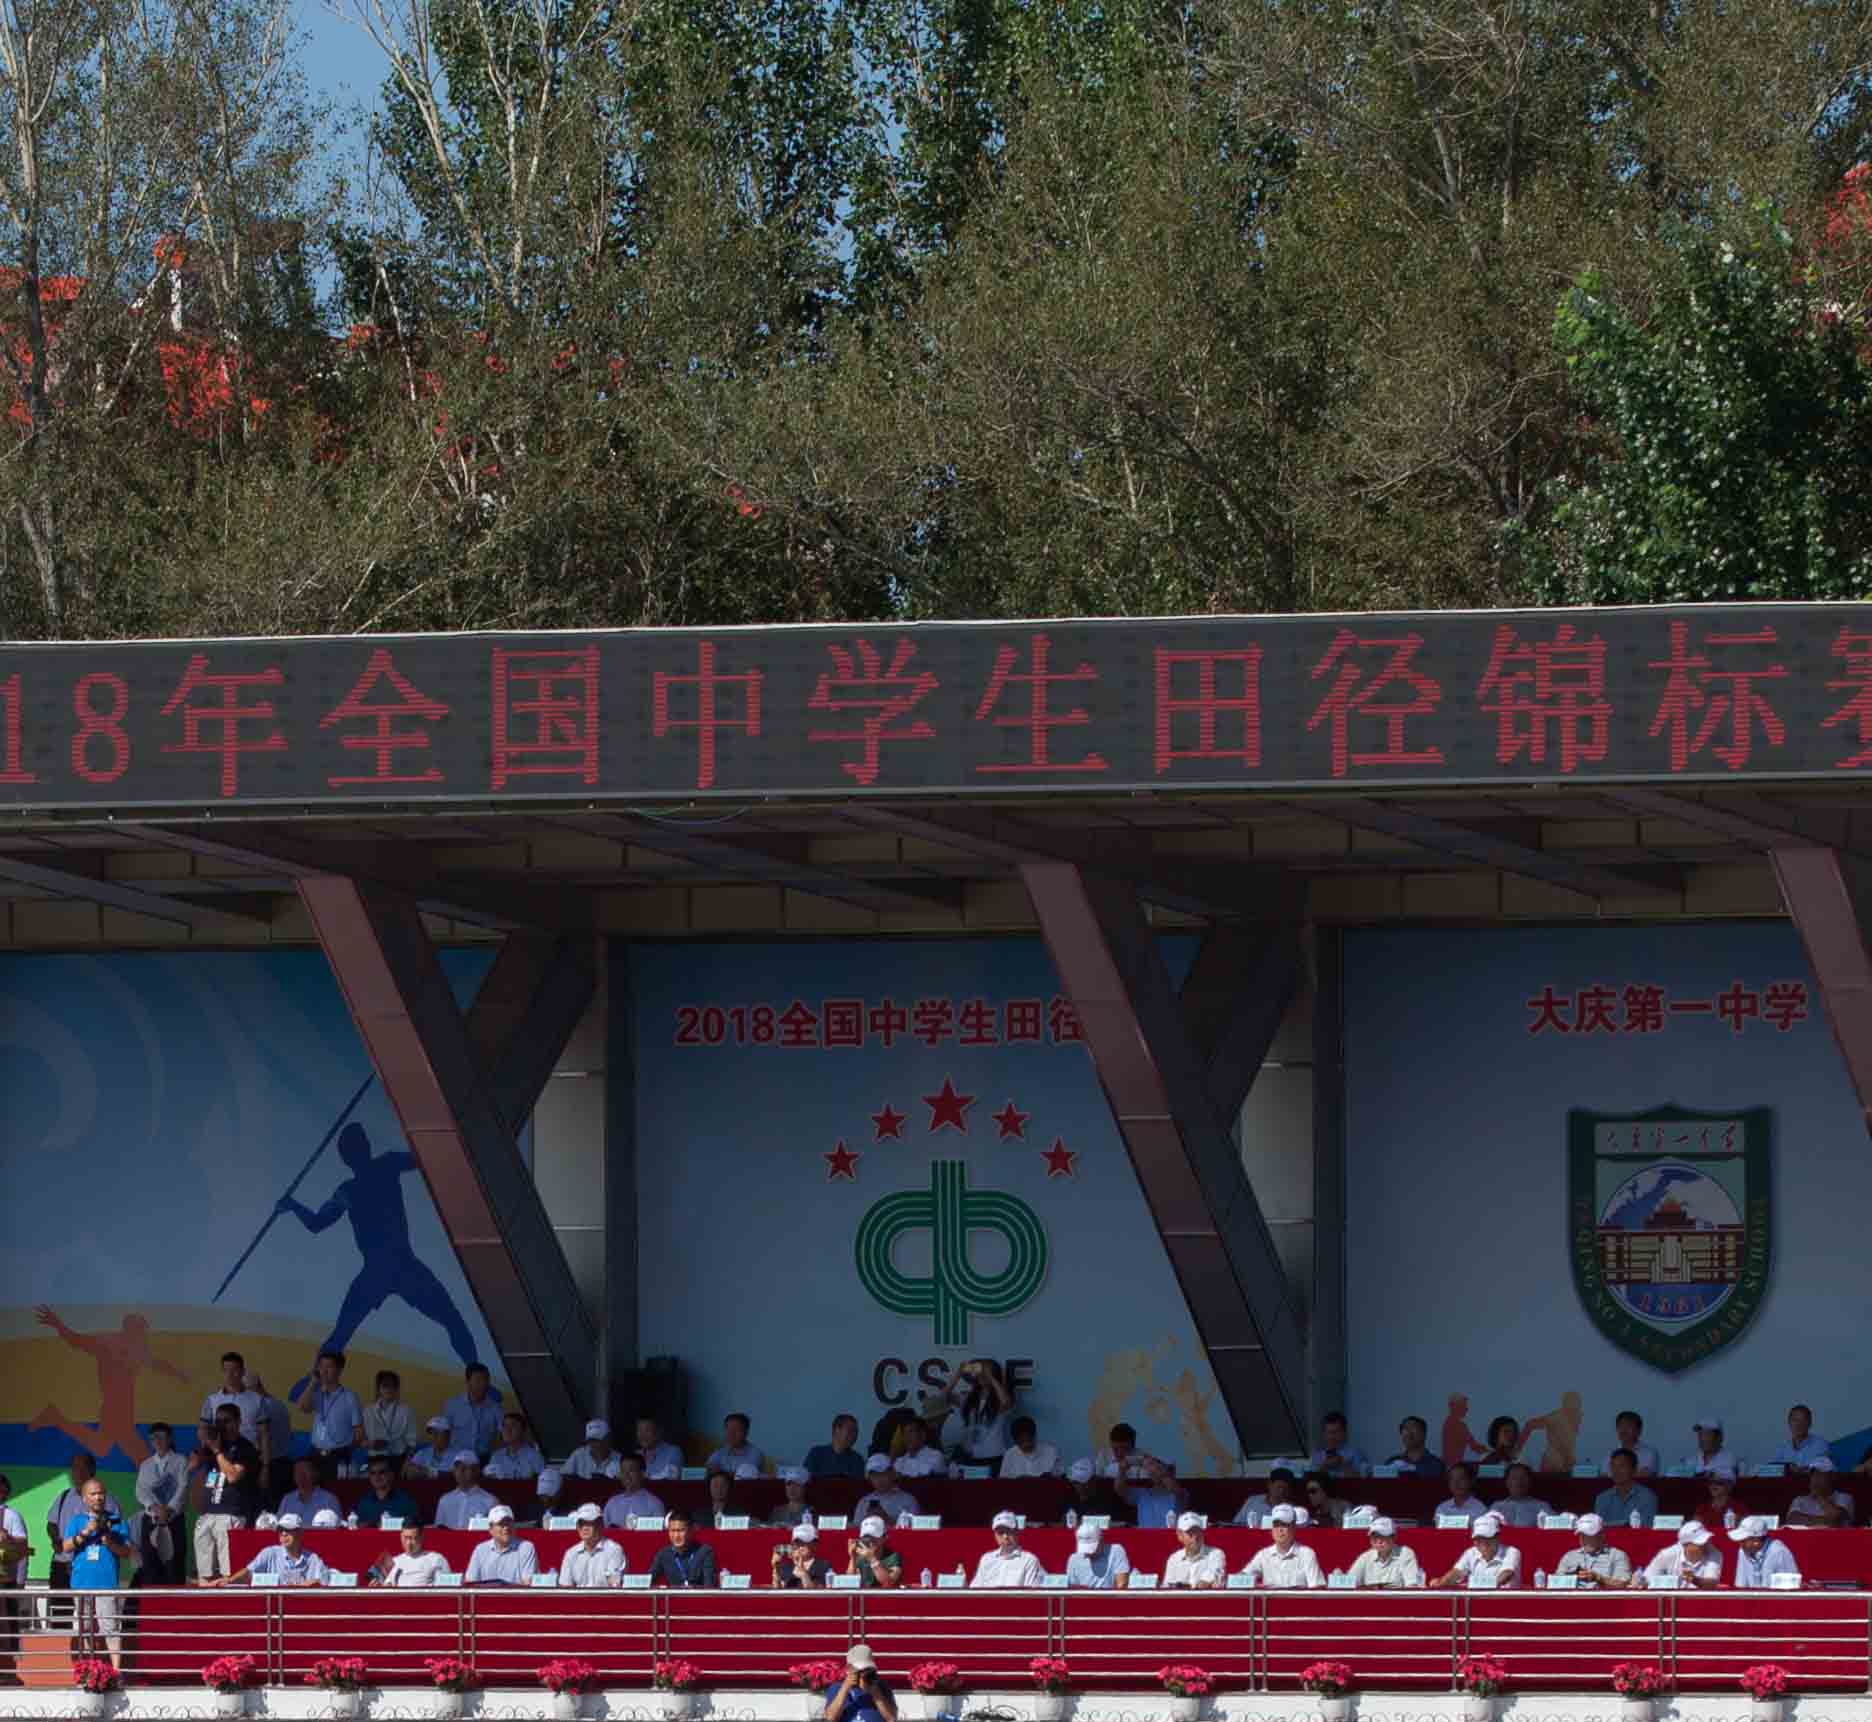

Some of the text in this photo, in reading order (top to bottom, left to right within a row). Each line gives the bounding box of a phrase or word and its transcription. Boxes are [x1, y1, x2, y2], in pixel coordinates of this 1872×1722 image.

[1527, 983, 1808, 1033] 大庆第一中学
